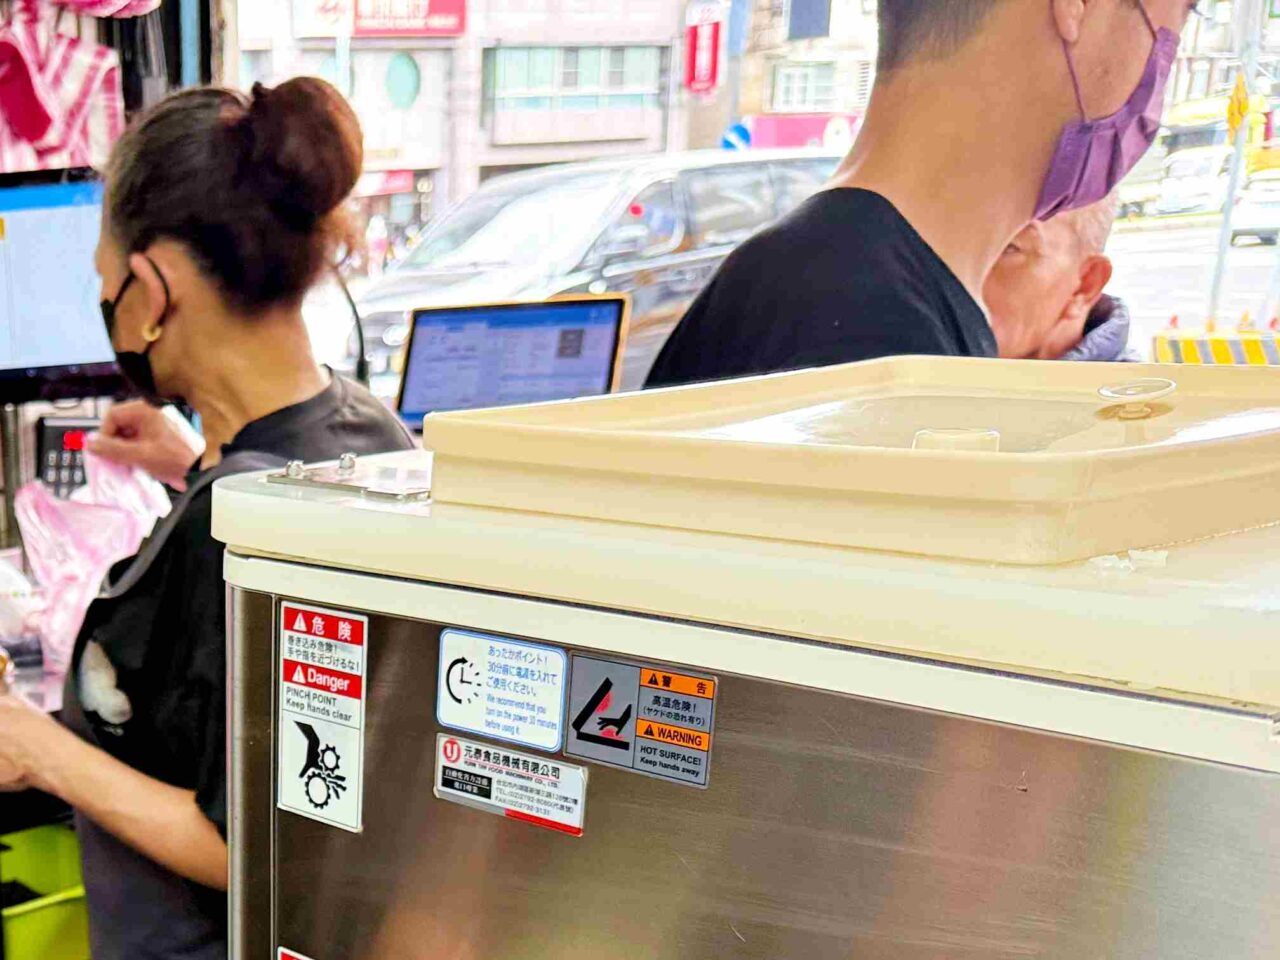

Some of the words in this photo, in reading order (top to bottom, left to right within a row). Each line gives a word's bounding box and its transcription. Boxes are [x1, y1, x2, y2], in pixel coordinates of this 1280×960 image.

[308, 668, 351, 692] Danger
[286, 687, 310, 700] PINCH
[313, 693, 337, 706] POINT
[286, 698, 305, 711] Keep
[307, 703, 331, 717] hands
[332, 710, 352, 721] clear
[658, 727, 702, 747] WARNING
[640, 745, 658, 756] HOT
[659, 750, 702, 766] SURFACE!
[640, 756, 657, 767] Keep
[659, 760, 680, 771] hands
[681, 765, 700, 778] away
